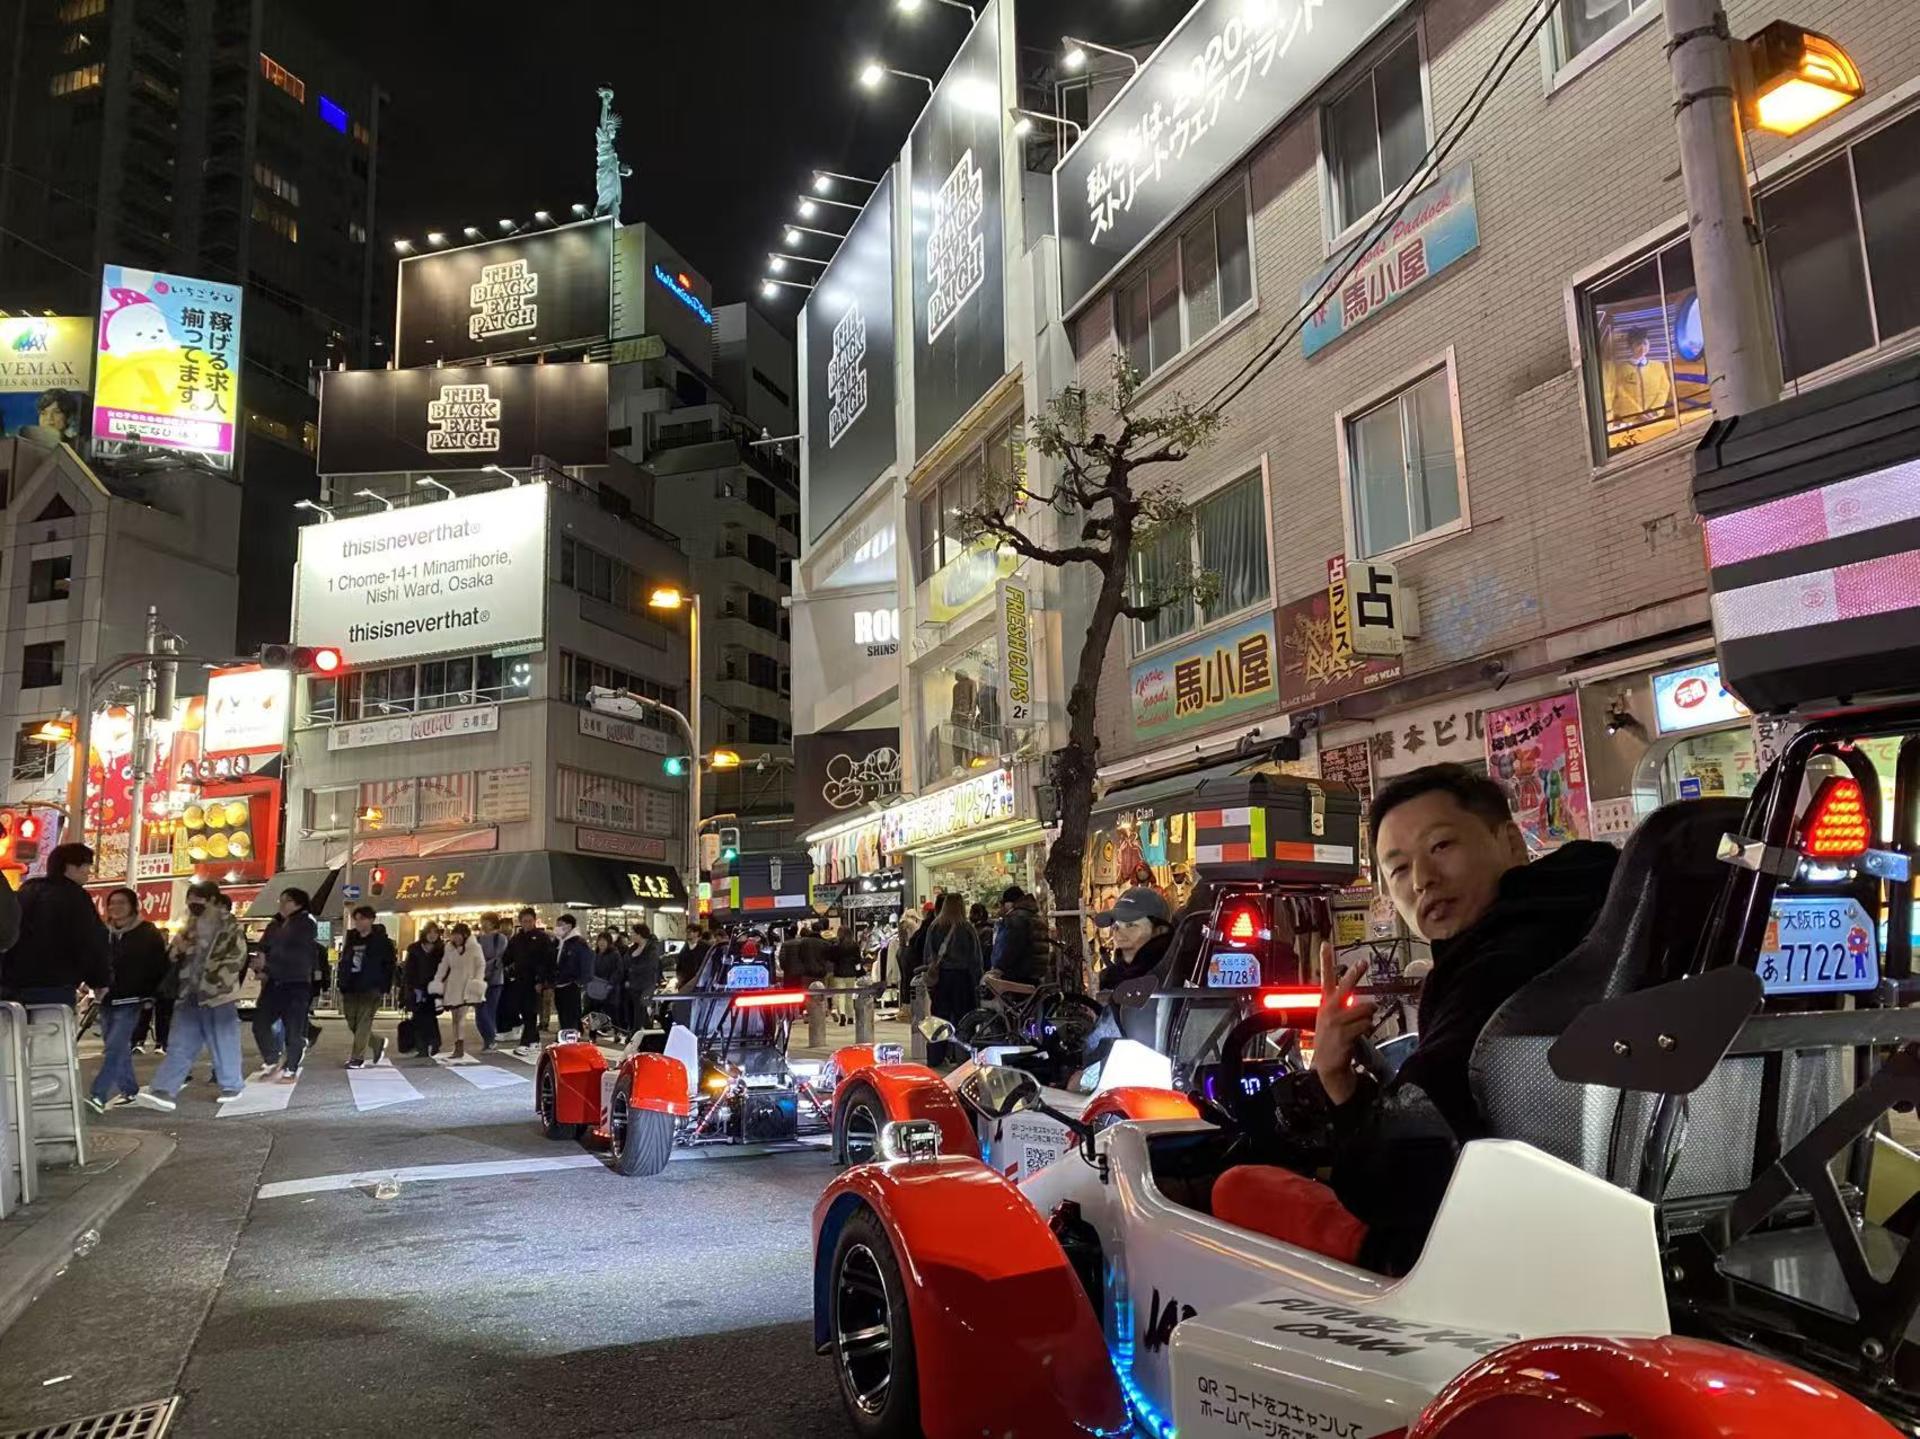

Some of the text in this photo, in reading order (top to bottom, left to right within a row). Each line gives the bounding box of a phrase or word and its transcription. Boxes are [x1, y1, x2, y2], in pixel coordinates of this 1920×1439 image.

[936, 162, 969, 224] THE
[930, 179, 980, 268] BLACK
[484, 263, 522, 285] THE
[939, 229, 969, 284] EYE
[474, 277, 534, 304] BLACK
[931, 247, 979, 332] PATCH
[1344, 237, 1428, 327] 馬小屋
[473, 308, 533, 334] PATCH
[485, 296, 520, 315] EYE
[836, 305, 858, 357] THE
[178, 307, 206, 412] 揃ってます。
[204, 311, 233, 415] 稼げる求人
[829, 322, 864, 394] BLACK
[32, 377, 81, 387] RESORTS
[443, 388, 485, 404] THE
[837, 359, 859, 408] EYE
[432, 403, 497, 419] BLACK
[445, 418, 481, 433] EYE
[829, 378, 865, 442] PATCH
[431, 432, 495, 448] PATCH
[342, 519, 481, 559] thisisneverthat®
[327, 549, 512, 592] 1 Chome-14-1 Minamihorie,
[1330, 559, 1344, 581] 占
[366, 573, 494, 606] Nishi Ward, Osaka
[1356, 566, 1395, 629] 占
[349, 606, 491, 643] thisisneverthat®
[1174, 634, 1271, 716] 馬小屋
[1380, 667, 1400, 681] WEAR
[1013, 705, 1028, 720] 2F
[1370, 708, 1485, 761] 橋本ビル
[1136, 808, 1154, 820] Clan
[395, 891, 418, 900] Face
[434, 889, 457, 898] Face
[1219, 970, 1249, 985] 7728
[1762, 943, 1849, 983] あ 7722
[1258, 1298, 1432, 1334] FUTURE
[1272, 1323, 1427, 1357] OSAKA
[1198, 1375, 1364, 1439] QR コードをスキャンして
